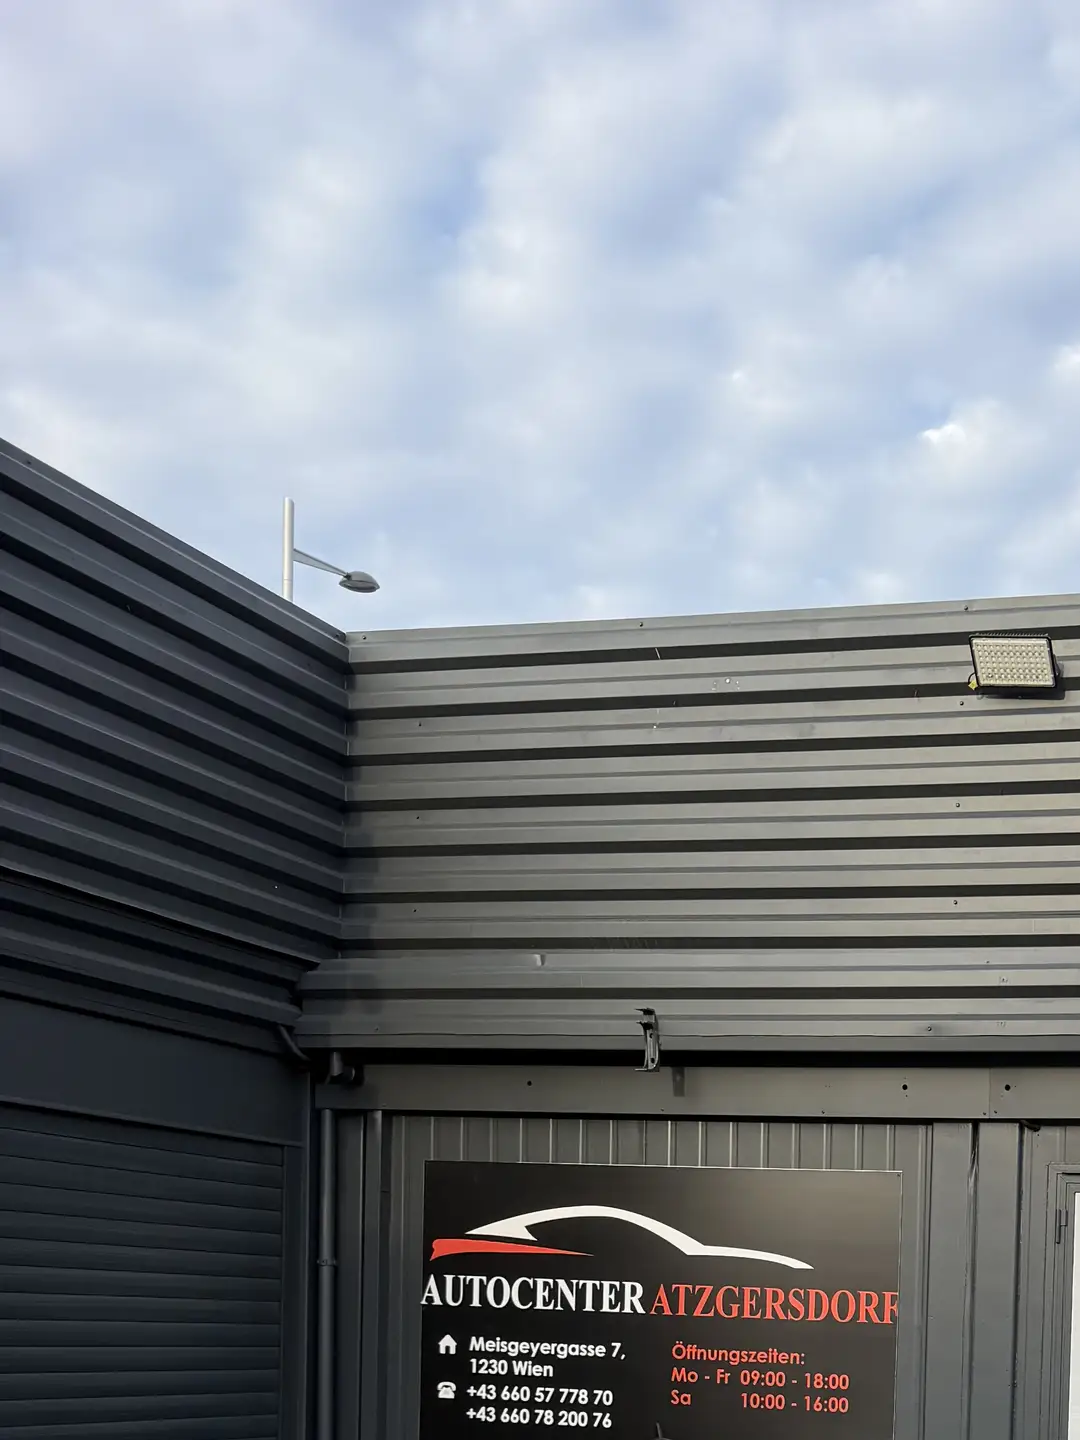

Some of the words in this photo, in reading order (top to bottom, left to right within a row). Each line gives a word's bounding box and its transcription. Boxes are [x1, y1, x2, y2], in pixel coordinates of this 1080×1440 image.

[420, 1273, 646, 1314] AUTOCENTER
[649, 1283, 898, 1324] ATZGERSDORF
[469, 1336, 607, 1359] Meisgeyergasse
[611, 1342, 626, 1360] 7,
[671, 1340, 805, 1366] Öffnungszeiten:
[469, 1357, 509, 1375] 1230
[512, 1360, 554, 1377] Wien
[671, 1367, 699, 1383] Mo
[716, 1368, 731, 1385] Fr
[740, 1369, 786, 1387] 09:00
[804, 1372, 850, 1390] 18:00
[466, 1384, 497, 1400] +43
[501, 1386, 531, 1402] 660
[534, 1387, 555, 1403] 57
[558, 1388, 589, 1405] 778
[593, 1389, 613, 1406] 70
[670, 1389, 692, 1406] Sa
[741, 1392, 786, 1410] 10:00
[804, 1395, 849, 1413] 16:00
[466, 1406, 496, 1422] +43
[500, 1408, 530, 1424] 660
[534, 1409, 554, 1425] 78
[557, 1410, 588, 1427] 200
[592, 1412, 612, 1428] 76
